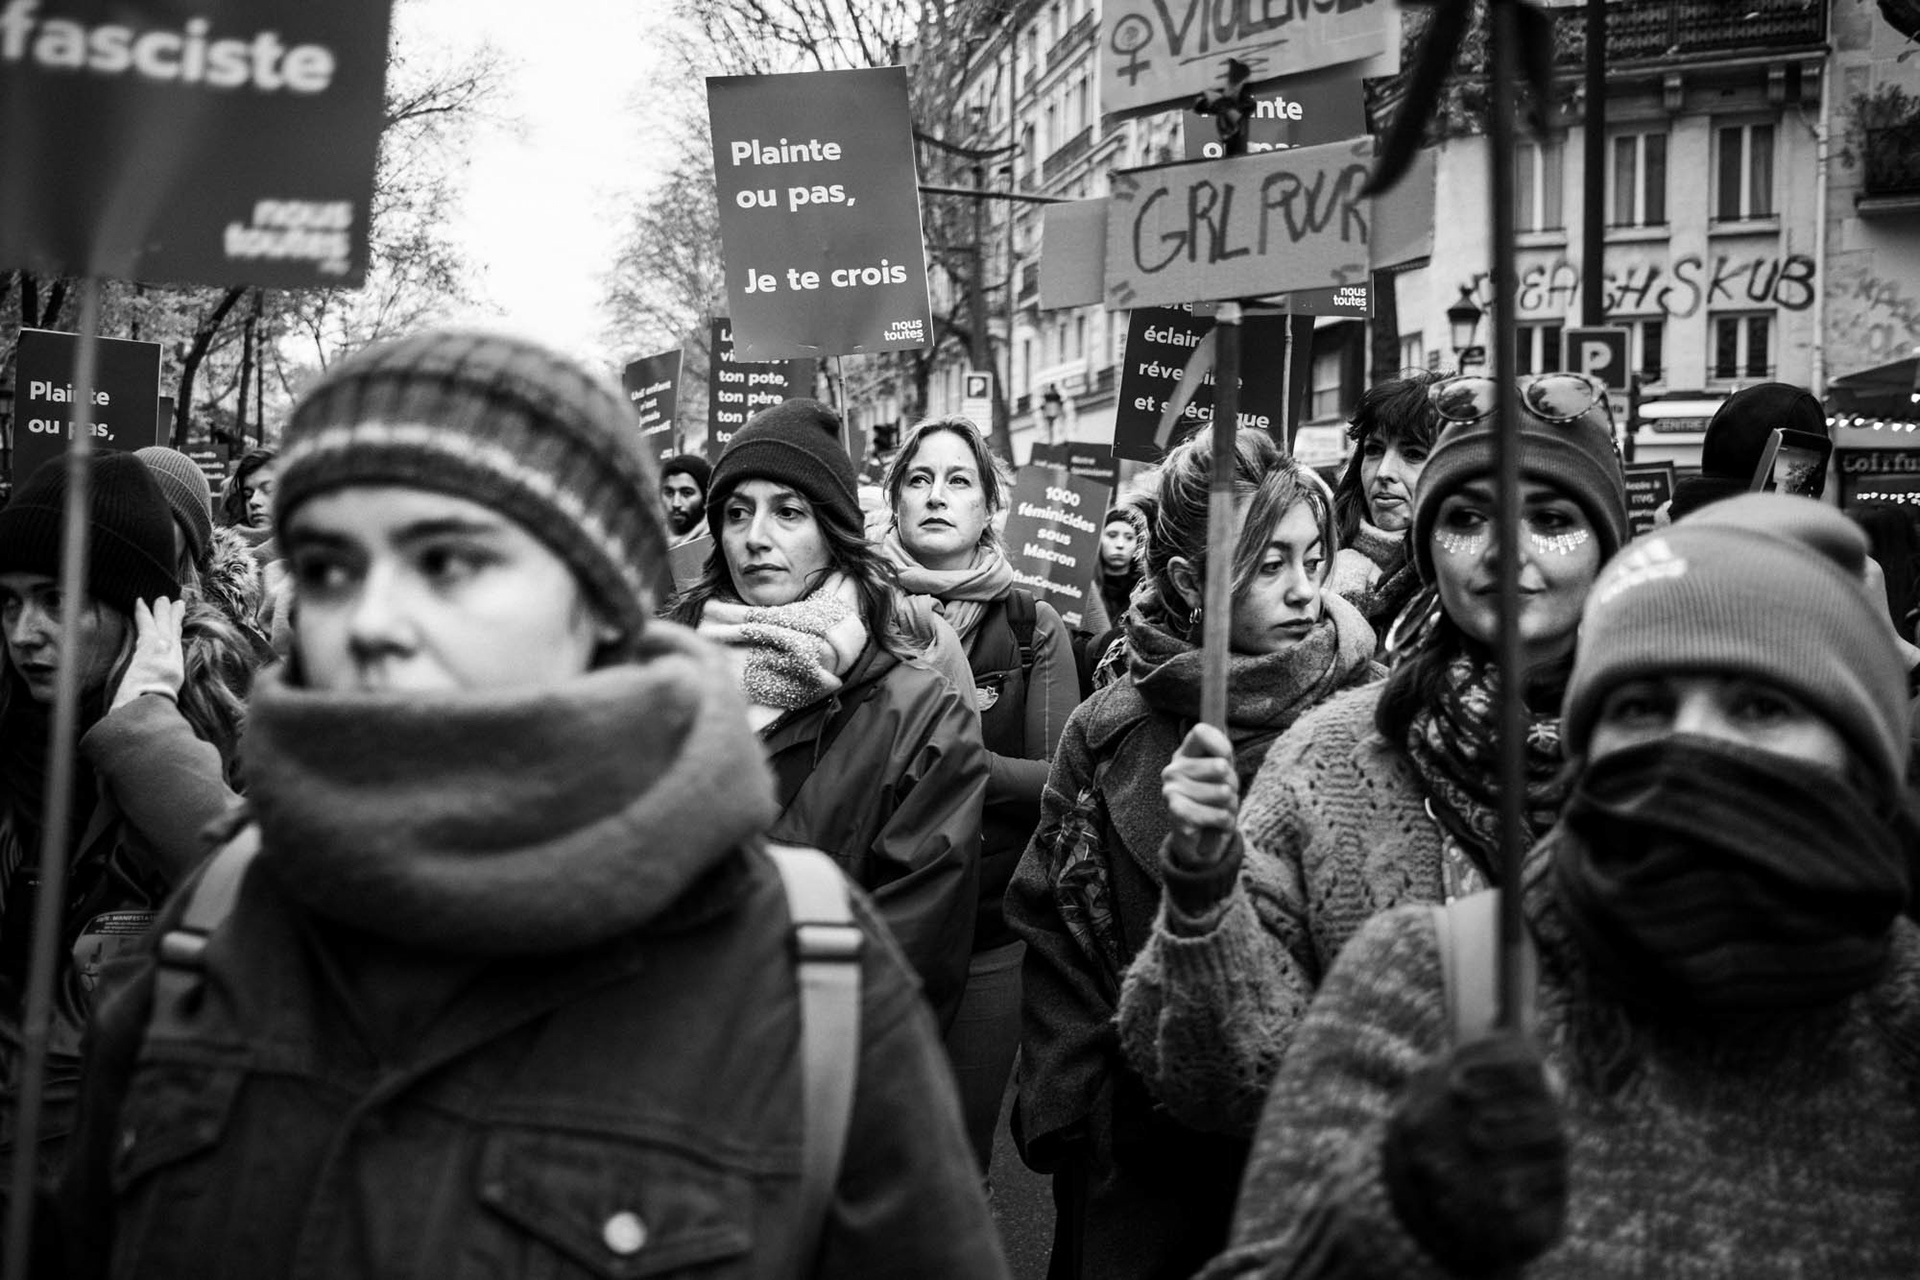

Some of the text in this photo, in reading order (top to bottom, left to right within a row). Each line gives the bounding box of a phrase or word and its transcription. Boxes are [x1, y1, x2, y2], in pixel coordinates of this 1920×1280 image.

[0, 0, 335, 93] fasciste
[731, 138, 842, 166] Plainte
[736, 184, 856, 212] ou pas,
[1133, 164, 1368, 274] GRL PWR
[745, 259, 907, 293] Je te crois
[1333, 294, 1367, 307] toutes
[1340, 287, 1367, 297] nous
[892, 319, 923, 331] nous
[884, 328, 924, 341] toutes
[718, 370, 789, 387] ton pote,
[717, 390, 783, 407] ton père
[1134, 396, 1155, 412] et
[716, 410, 743, 423] ton
[28, 418, 60, 434] ou
[1045, 486, 1081, 507] 1000
[1017, 502, 1097, 533] féminicides
[1037, 527, 1071, 546] sous
[1023, 542, 1077, 568] Macron
